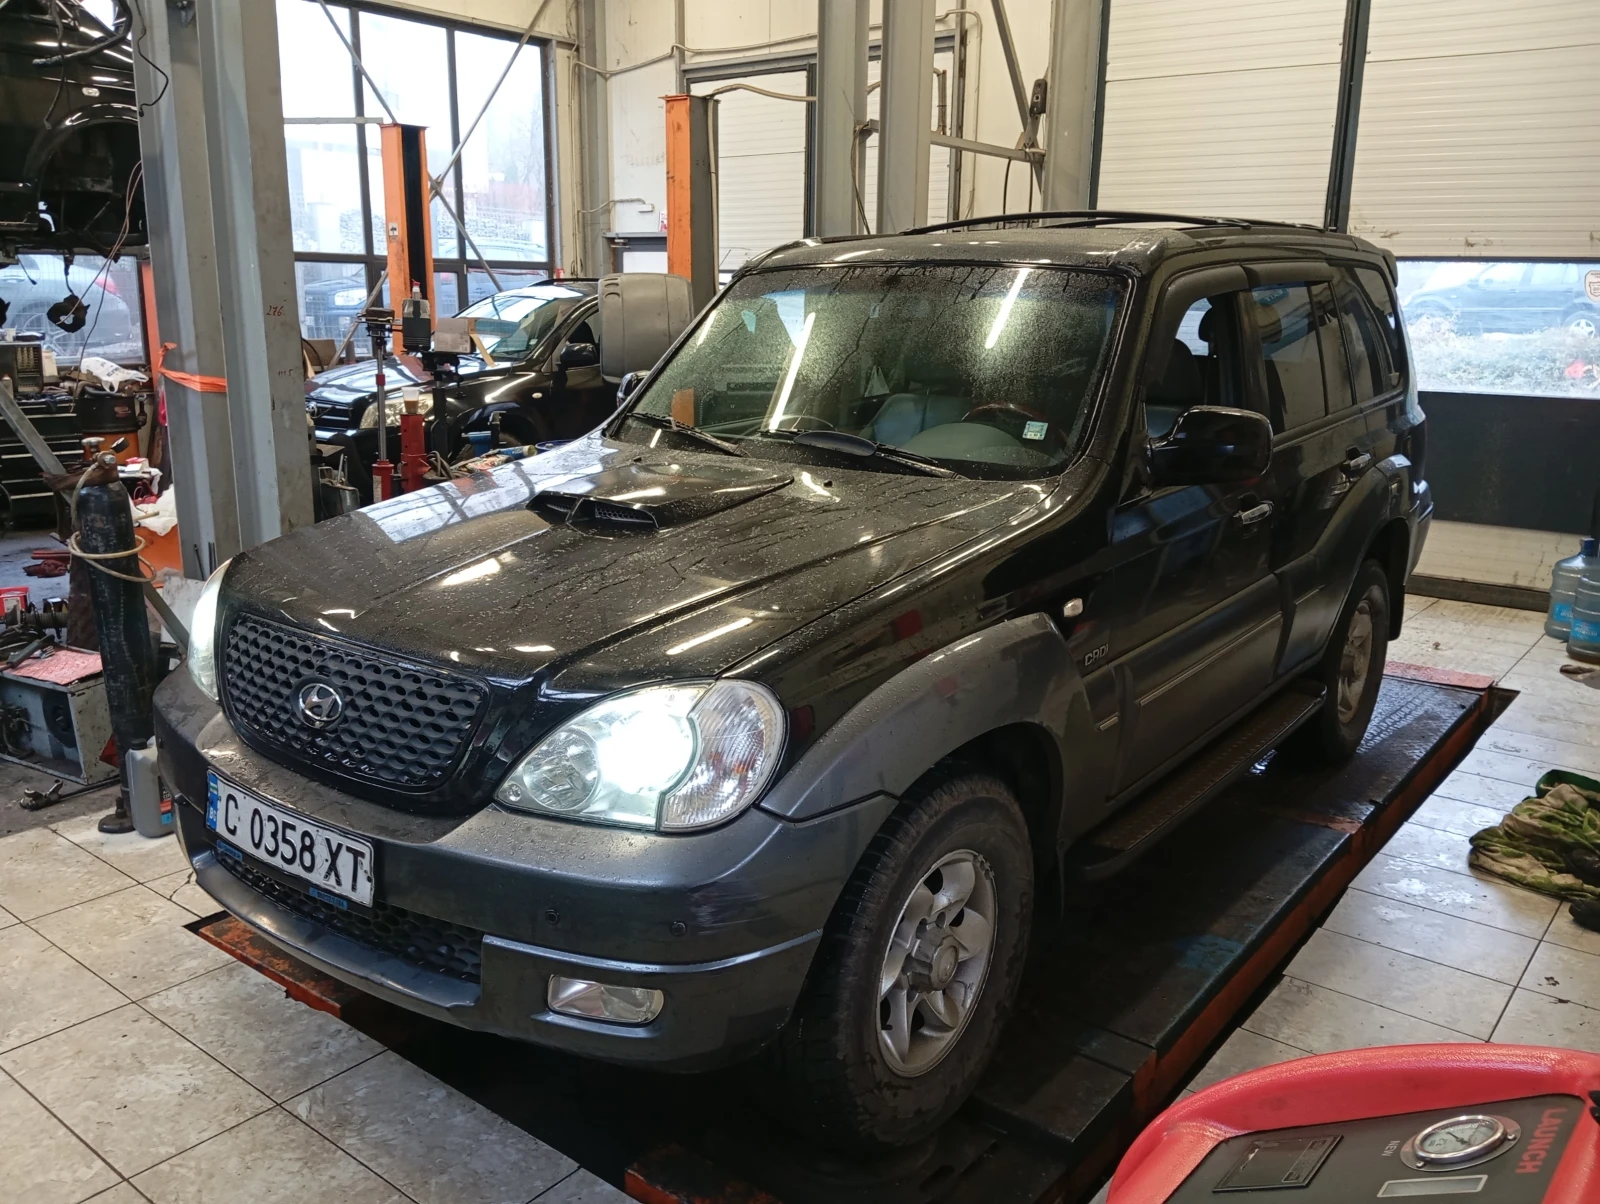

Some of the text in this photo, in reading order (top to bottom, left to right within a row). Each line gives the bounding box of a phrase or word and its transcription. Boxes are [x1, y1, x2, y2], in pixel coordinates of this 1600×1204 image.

[209, 806, 218, 822] BG
[225, 793, 366, 893] C 0358 XT
[1515, 1107, 1568, 1173] LAUNCH
